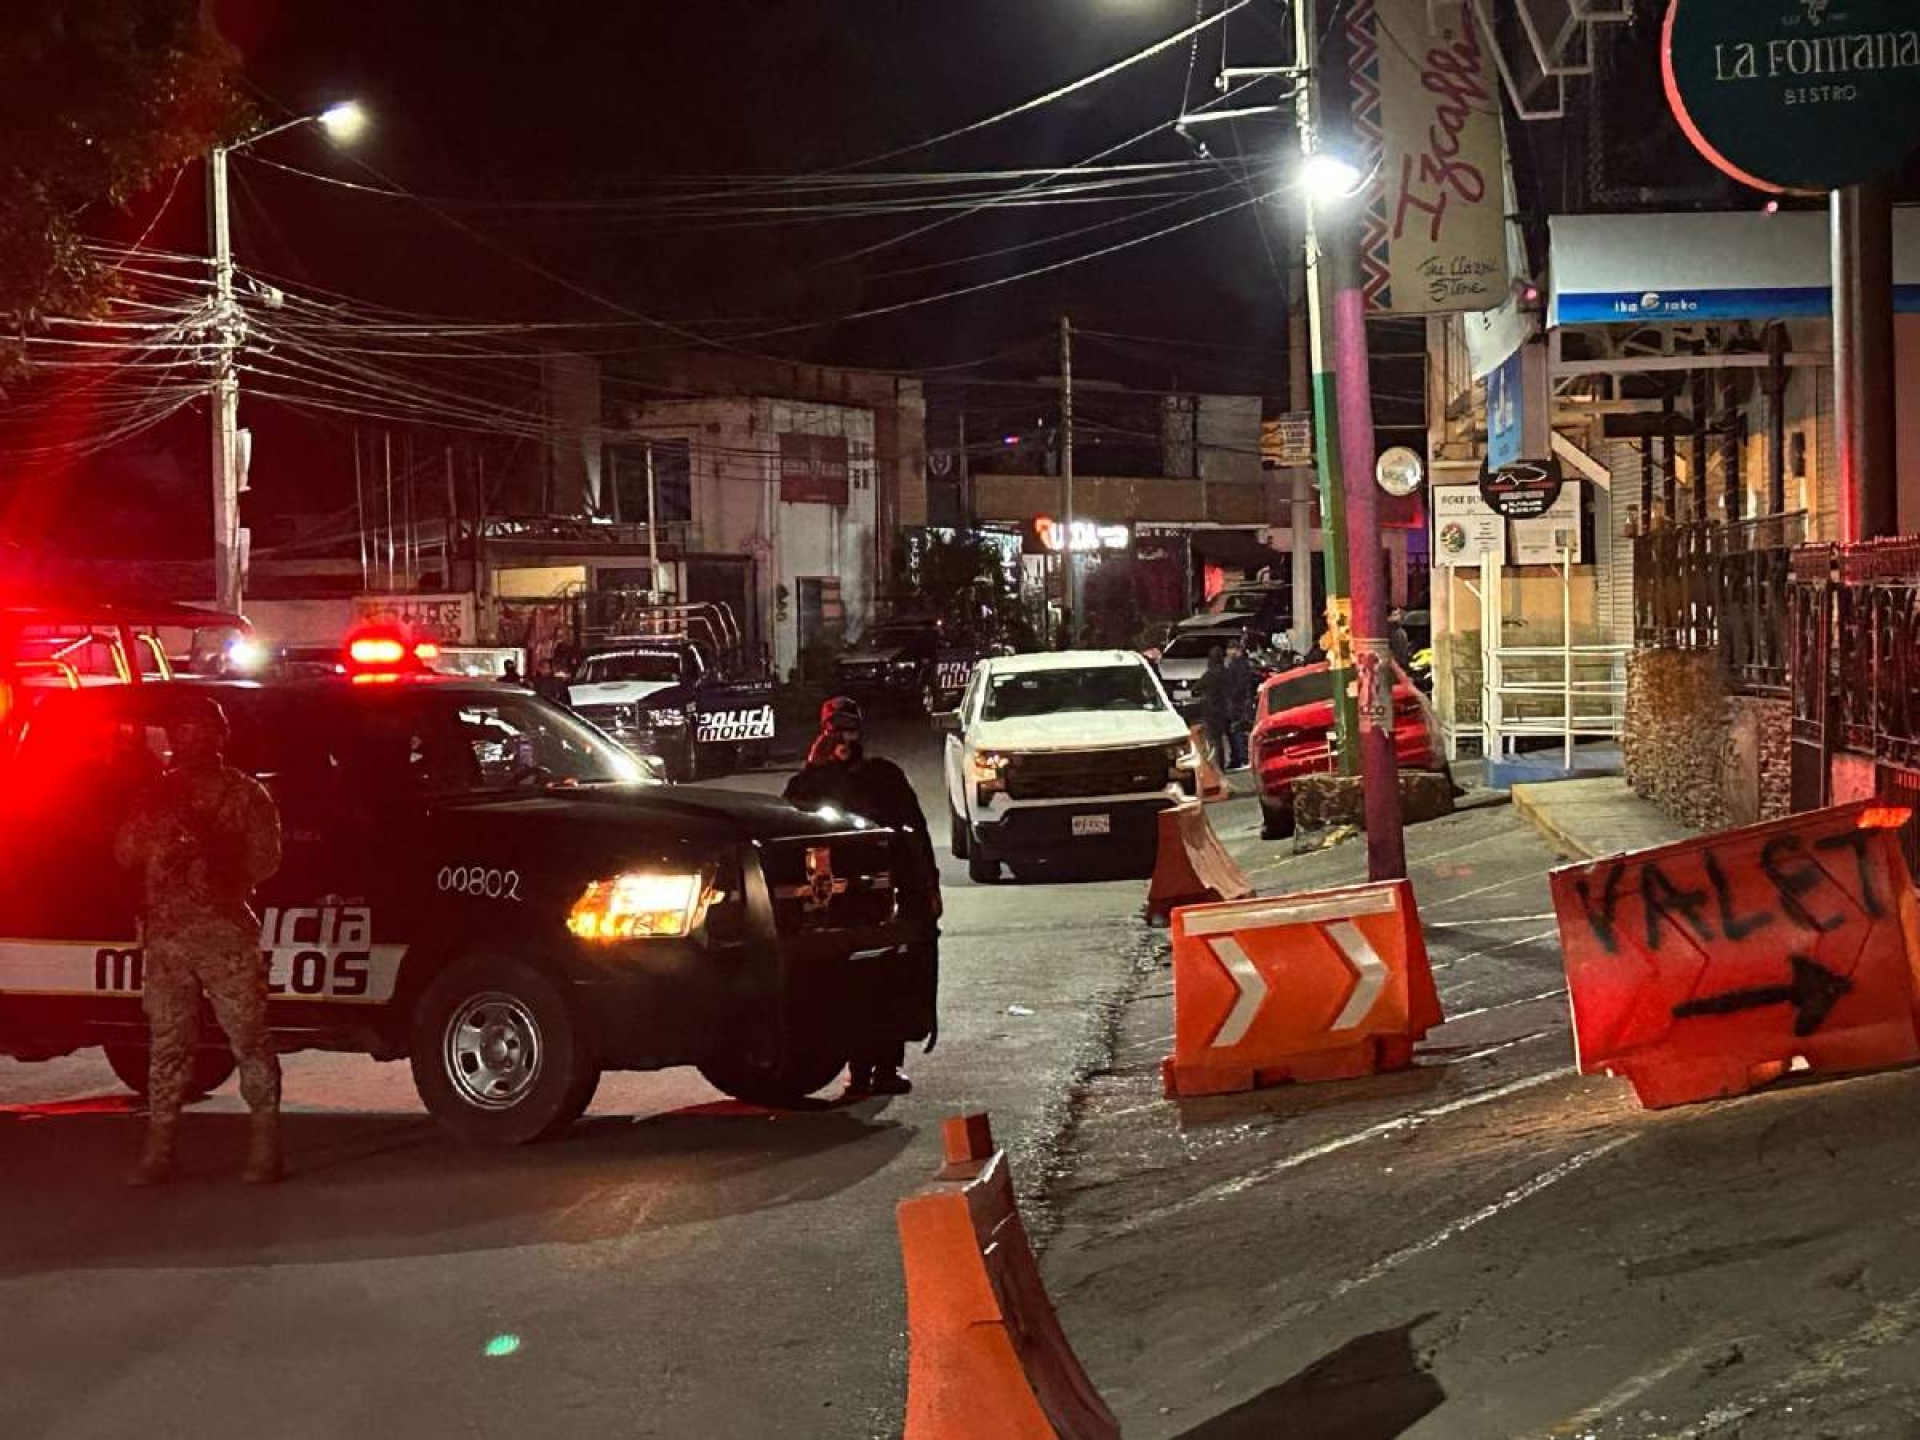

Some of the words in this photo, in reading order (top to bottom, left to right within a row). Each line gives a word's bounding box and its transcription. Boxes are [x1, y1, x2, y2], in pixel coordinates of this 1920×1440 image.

[1783, 85, 1857, 104] BISTRO
[437, 866, 523, 902] 00802
[1575, 828, 1884, 953] VALET
